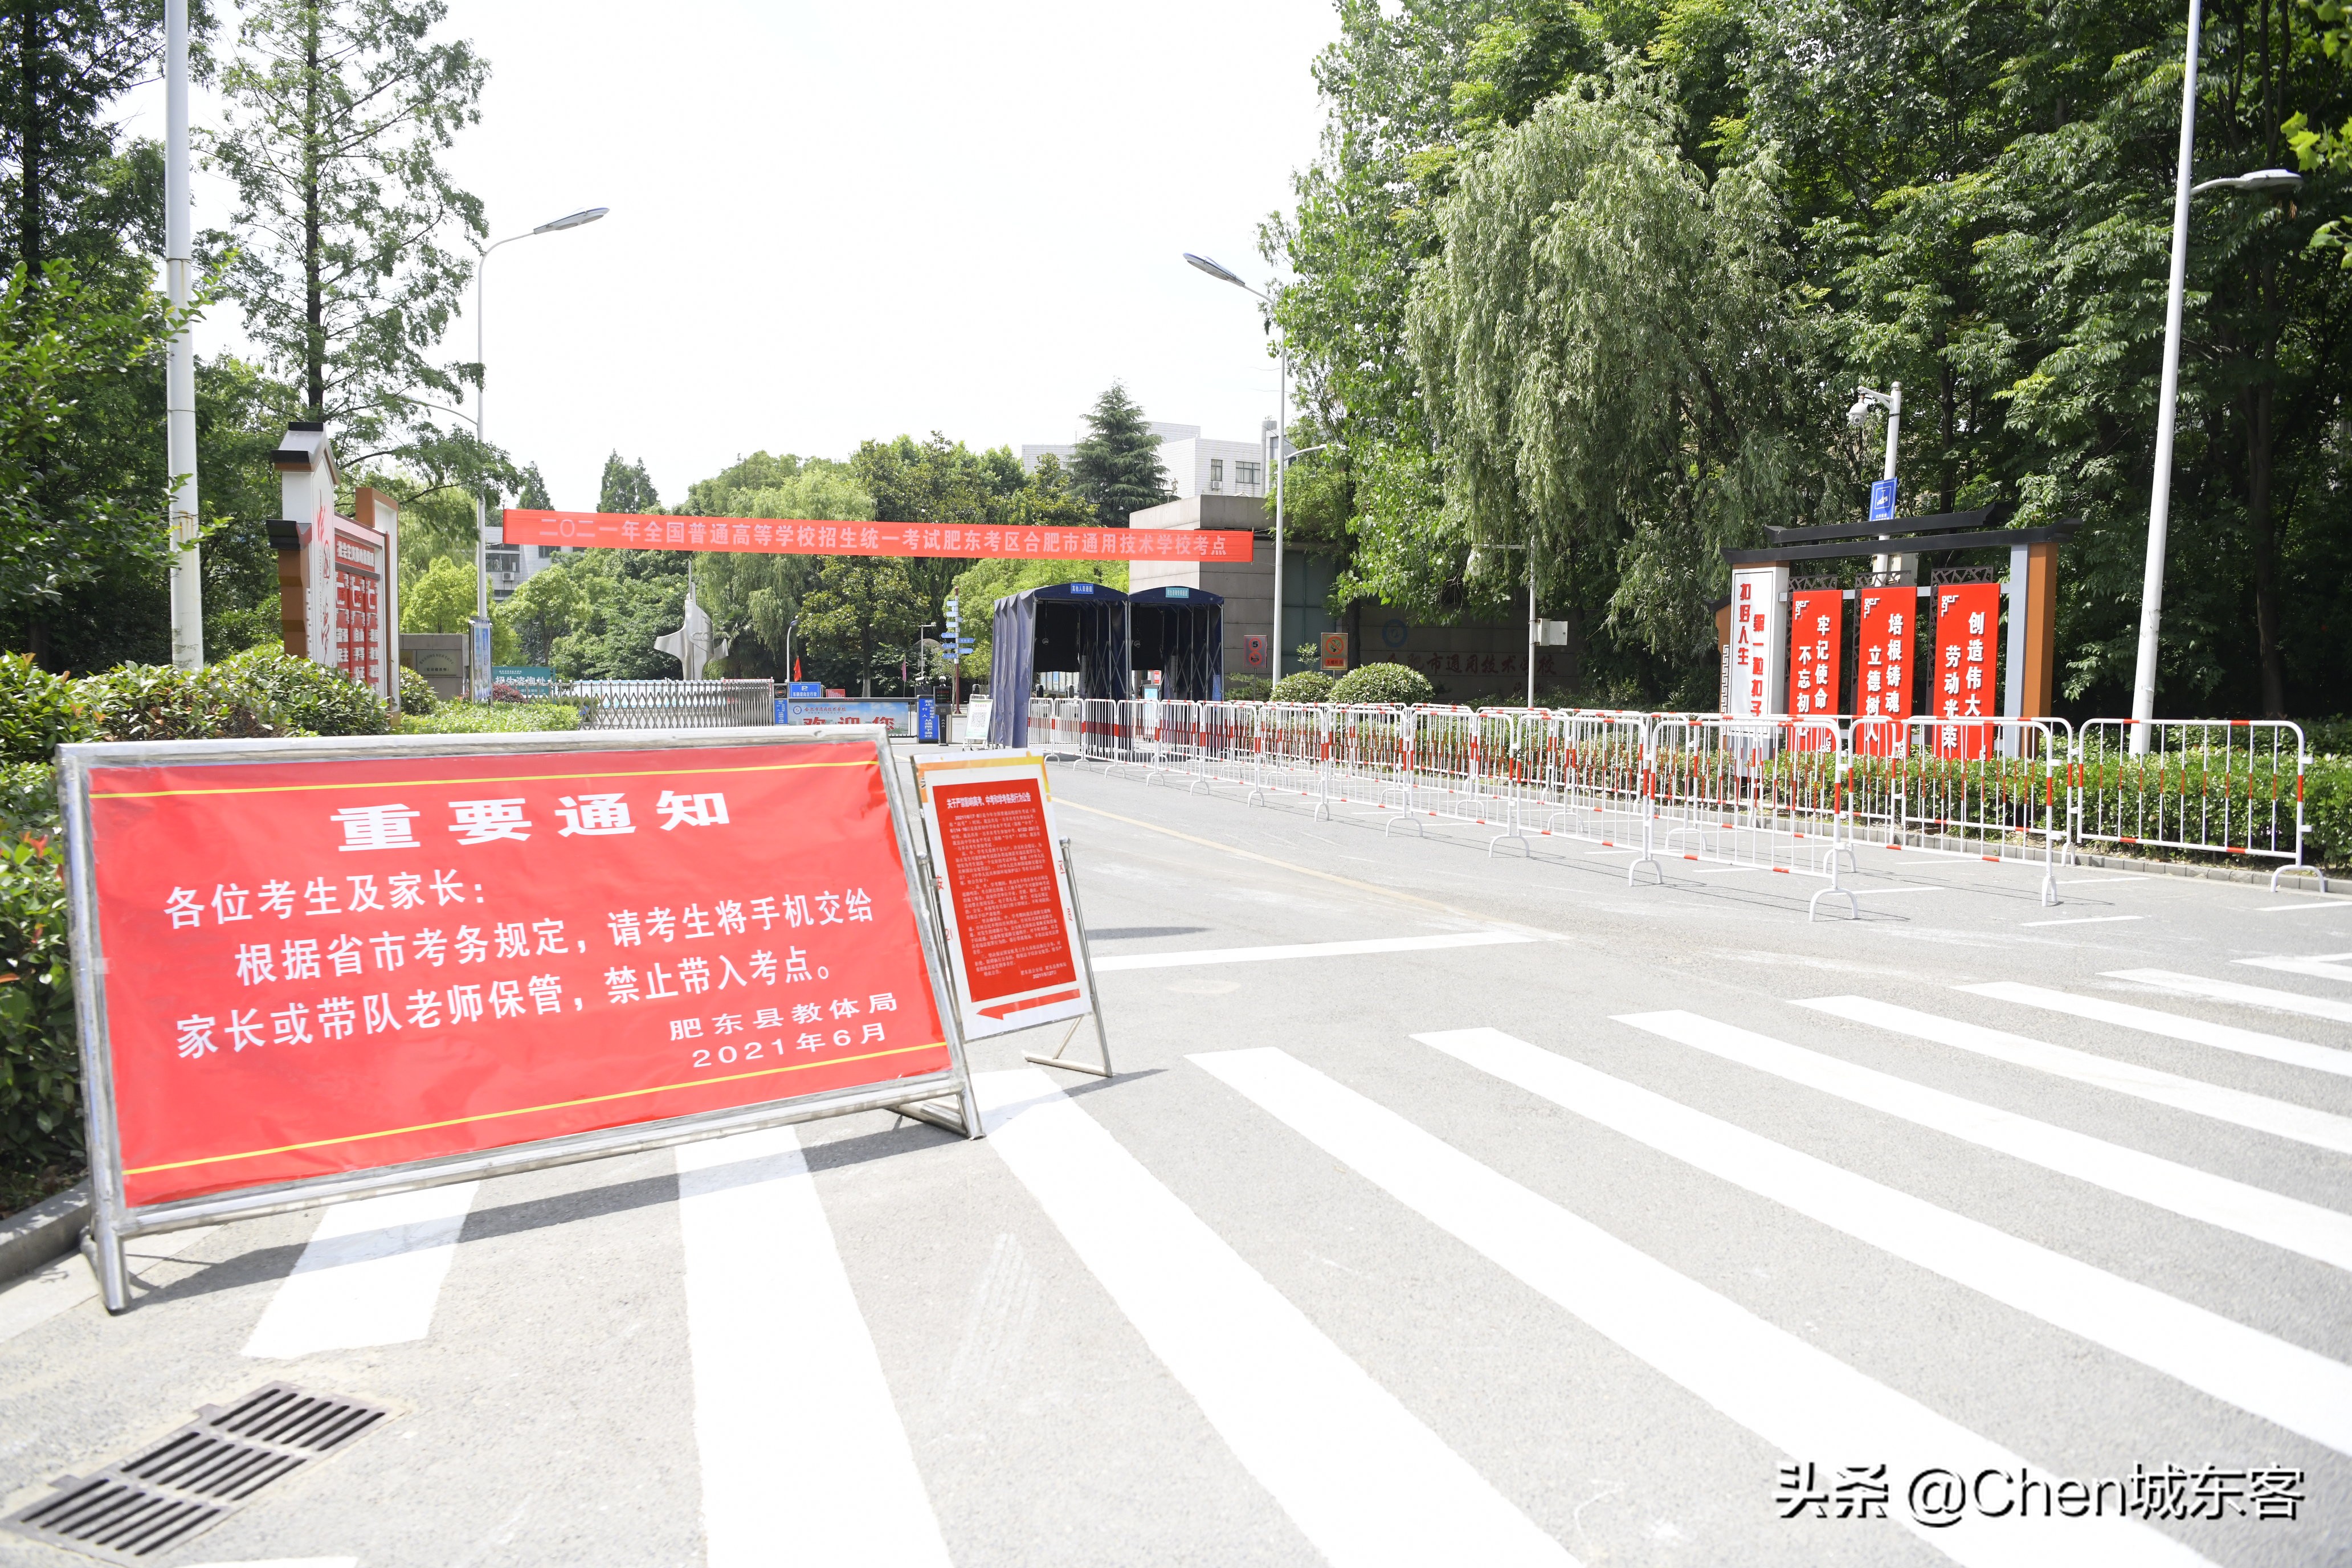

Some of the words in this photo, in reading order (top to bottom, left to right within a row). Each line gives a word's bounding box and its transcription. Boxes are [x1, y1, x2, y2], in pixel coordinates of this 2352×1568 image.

[336, 648, 349, 662] 民主
[353, 647, 365, 661] 平等
[1738, 583, 1751, 665] 扣好人生
[1750, 614, 1765, 717] 第一粒扣子
[1815, 615, 1831, 709] 牢记使命
[1885, 613, 1904, 713] 培根铸魂
[1964, 612, 1985, 717] 创造伟大
[803, 716, 895, 731] 欢迎您
[1865, 646, 1882, 742] 立德树人
[1942, 645, 1961, 749] 劳动光荣
[330, 790, 730, 852] 重要通知
[164, 869, 484, 929] 各位考生及家长：
[235, 888, 872, 986] 根据省市考务规定，请考生将手机交给
[176, 945, 830, 1060] 家长或带队老师保管，禁止带入考点。
[669, 992, 897, 1042] 肥东县教体局
[693, 1022, 887, 1068] 2021年6月
